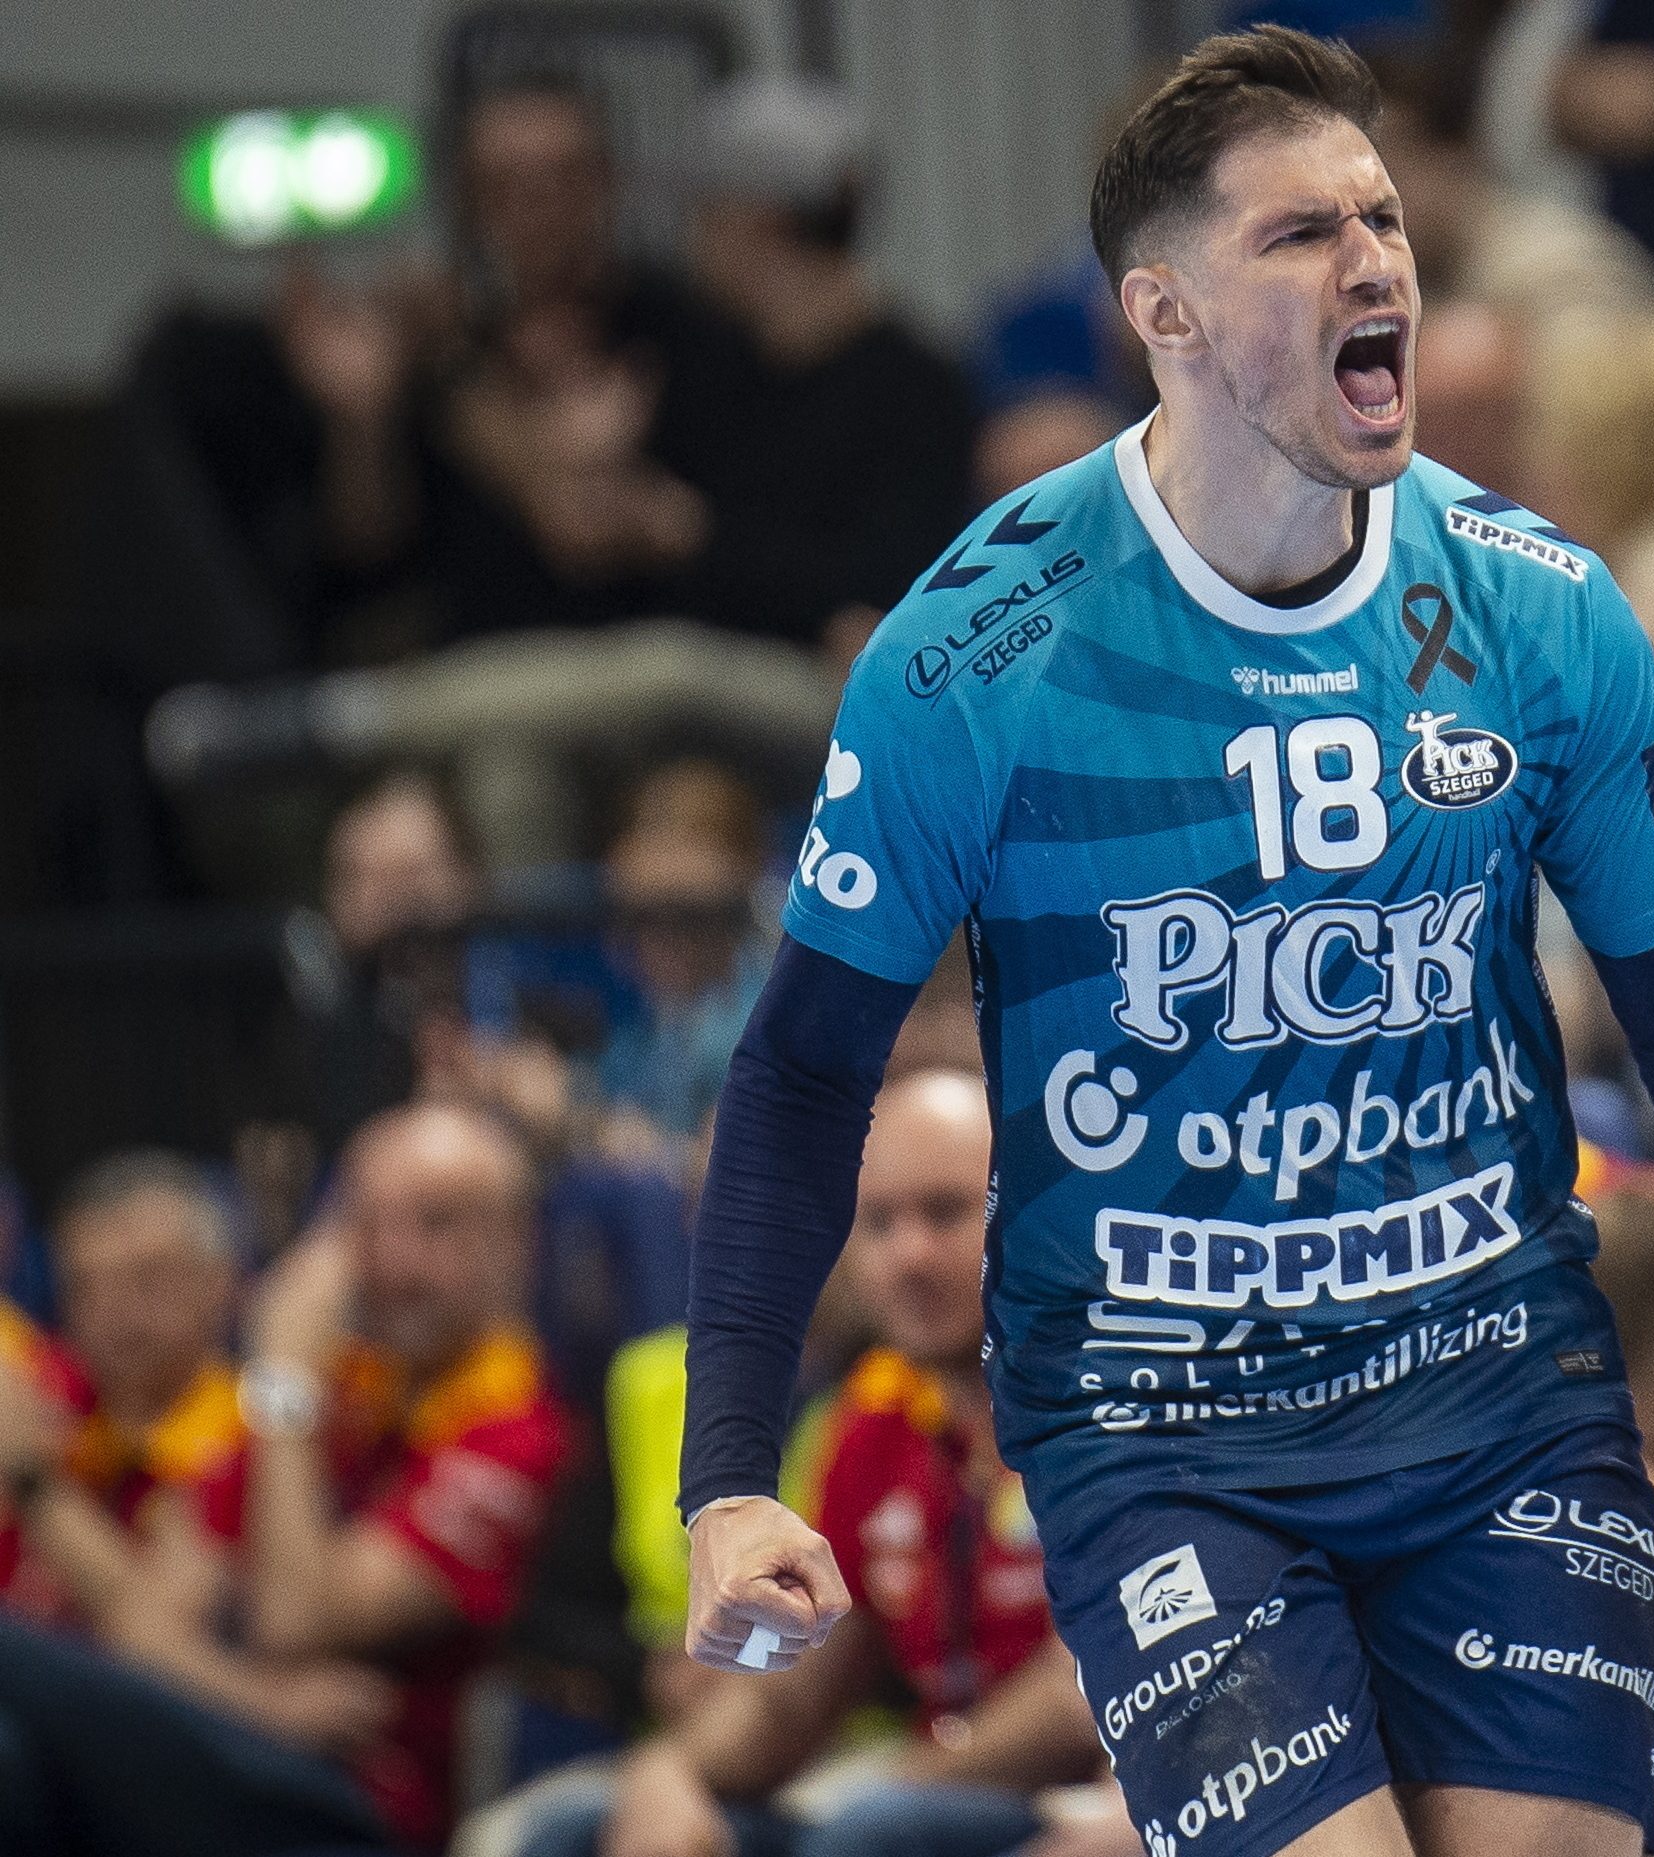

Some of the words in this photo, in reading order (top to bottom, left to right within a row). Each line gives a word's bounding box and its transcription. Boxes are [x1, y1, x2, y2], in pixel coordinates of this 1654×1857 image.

[945, 549, 1086, 650] LEXUS
[971, 614, 1053, 686] SZEGED
[1262, 664, 1360, 694] hummel
[1224, 714, 1389, 880] 18
[1430, 771, 1494, 797] SZEGED
[1102, 884, 1486, 1050] PICK
[1177, 1018, 1535, 1200] otpbank
[1565, 1547, 1654, 1601] SZEGED
